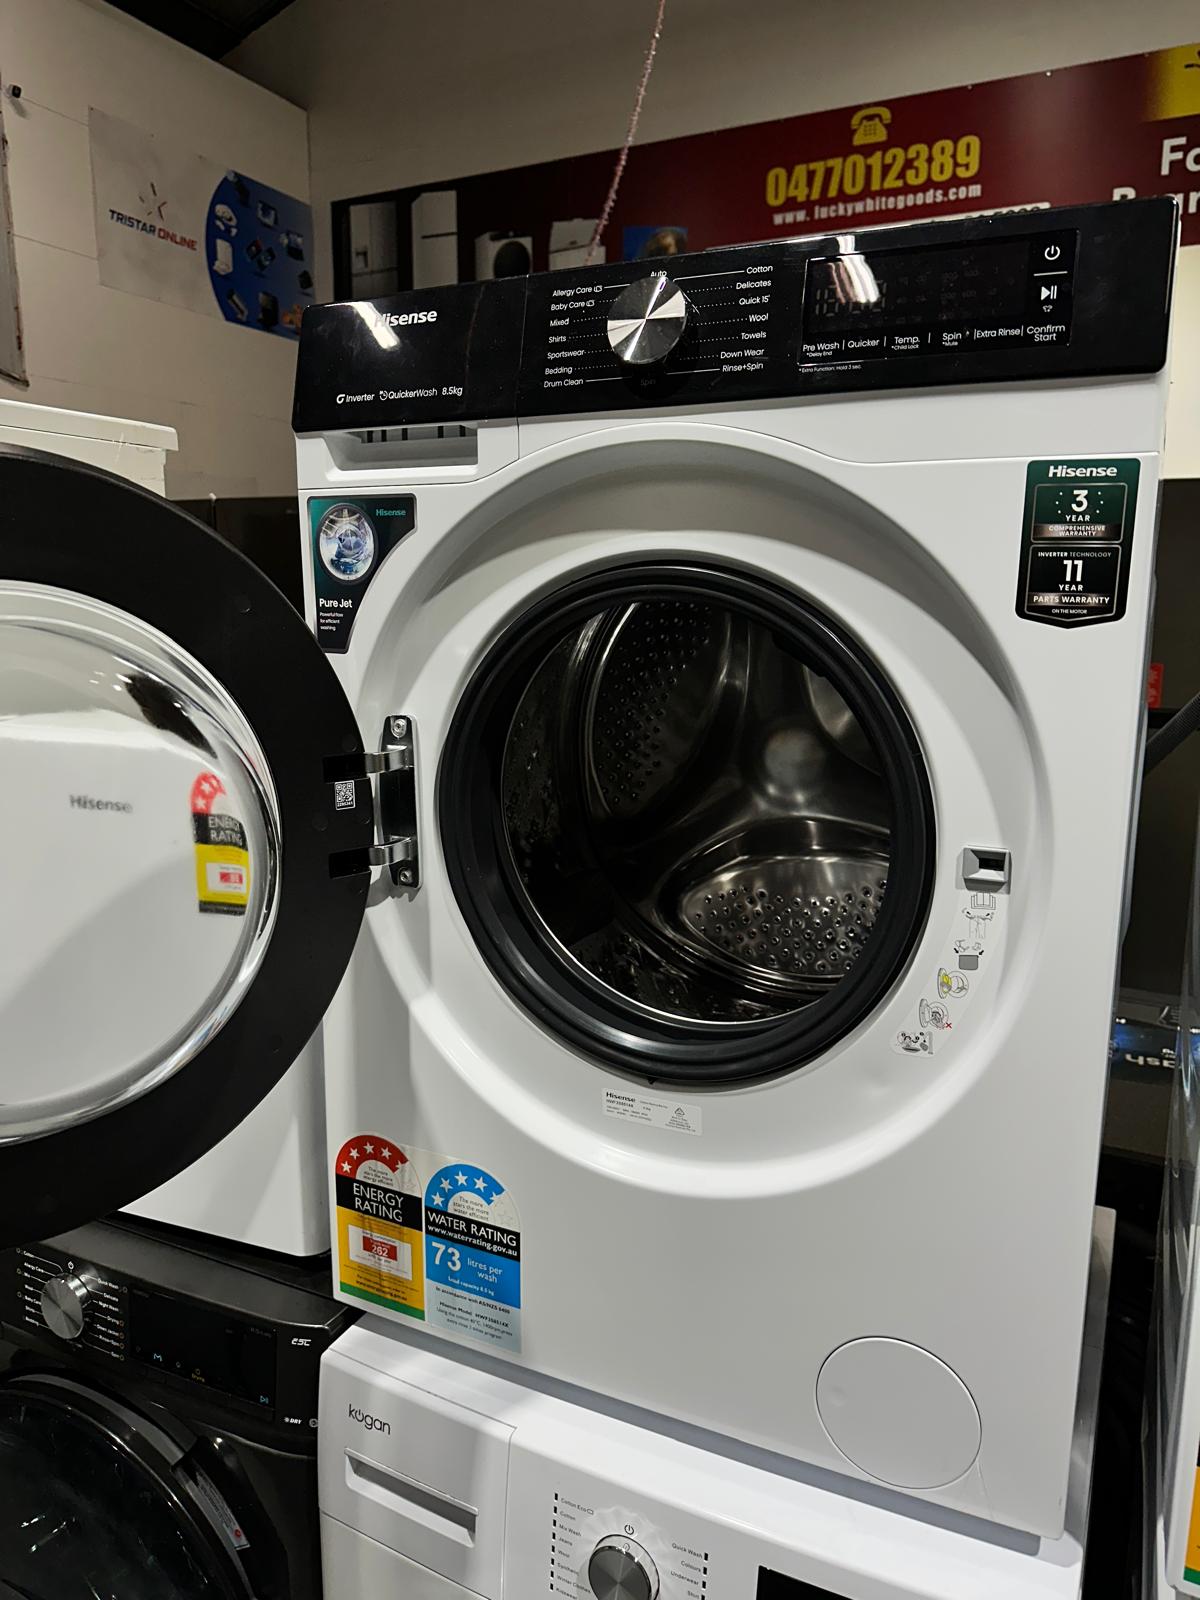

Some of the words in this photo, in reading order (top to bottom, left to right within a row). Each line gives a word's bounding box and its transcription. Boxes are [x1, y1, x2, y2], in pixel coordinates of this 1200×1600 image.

[766, 135, 981, 207] 0477012389
[109, 208, 156, 236] TRISTAR
[157, 227, 197, 251] ONLINE
[746, 265, 774, 274] Cotton
[735, 279, 772, 290] Delicates
[552, 287, 575, 297] Allergy
[575, 286, 593, 295] Care
[550, 302, 568, 312] Baby
[569, 301, 585, 309] Care
[738, 296, 761, 306] Quick
[374, 310, 438, 328] Hisense
[549, 318, 570, 327] Mixed
[748, 313, 769, 323] Wool
[976, 329, 997, 339] Extra
[998, 328, 1021, 337] Rinse
[1026, 324, 1066, 335] Confirm
[548, 336, 567, 344] Shirts
[741, 331, 767, 340] Towels
[893, 335, 920, 345] Temp.
[942, 331, 962, 342] Spin
[1034, 333, 1057, 342] Start
[802, 344, 816, 352] Pre
[817, 342, 840, 351] Wash
[847, 339, 880, 349] Quicker
[547, 349, 585, 361] Sportswear
[720, 350, 743, 359] Down
[743, 349, 765, 358] Wear
[544, 366, 573, 376] Bedding
[722, 361, 764, 373] Rinse+Spin
[543, 379, 562, 388] Drum
[563, 378, 584, 387] Clean
[345, 393, 375, 403] Inverter
[388, 388, 438, 400] QuickerWash
[441, 386, 463, 397] 8.5kg
[1048, 464, 1118, 478] Hisense
[1071, 489, 1088, 513] 3
[375, 508, 407, 517] Hisense
[1065, 514, 1091, 522] YEAR
[1048, 524, 1106, 532] COMPREHENSIVE
[1063, 559, 1083, 582] 11
[1058, 584, 1084, 592] YEAR
[319, 598, 338, 608] Pure
[339, 598, 353, 608] Jet
[1033, 595, 1060, 604] PARTS
[1061, 595, 1110, 605] WARRANTY
[69, 795, 133, 814] Hisense
[606, 1091, 636, 1103] Hisense
[353, 1183, 404, 1208] ENERGY
[355, 1197, 403, 1222] RATING
[427, 1211, 467, 1233] WATER
[471, 1223, 517, 1247] RATING
[427, 1225, 518, 1256] www.waterrating.gov.au
[371, 1244, 389, 1257] 262
[431, 1241, 462, 1272] 73
[467, 1257, 487, 1271] litres
[489, 1265, 503, 1276] per
[477, 1271, 498, 1284] wash
[348, 1403, 391, 1435] kogan
